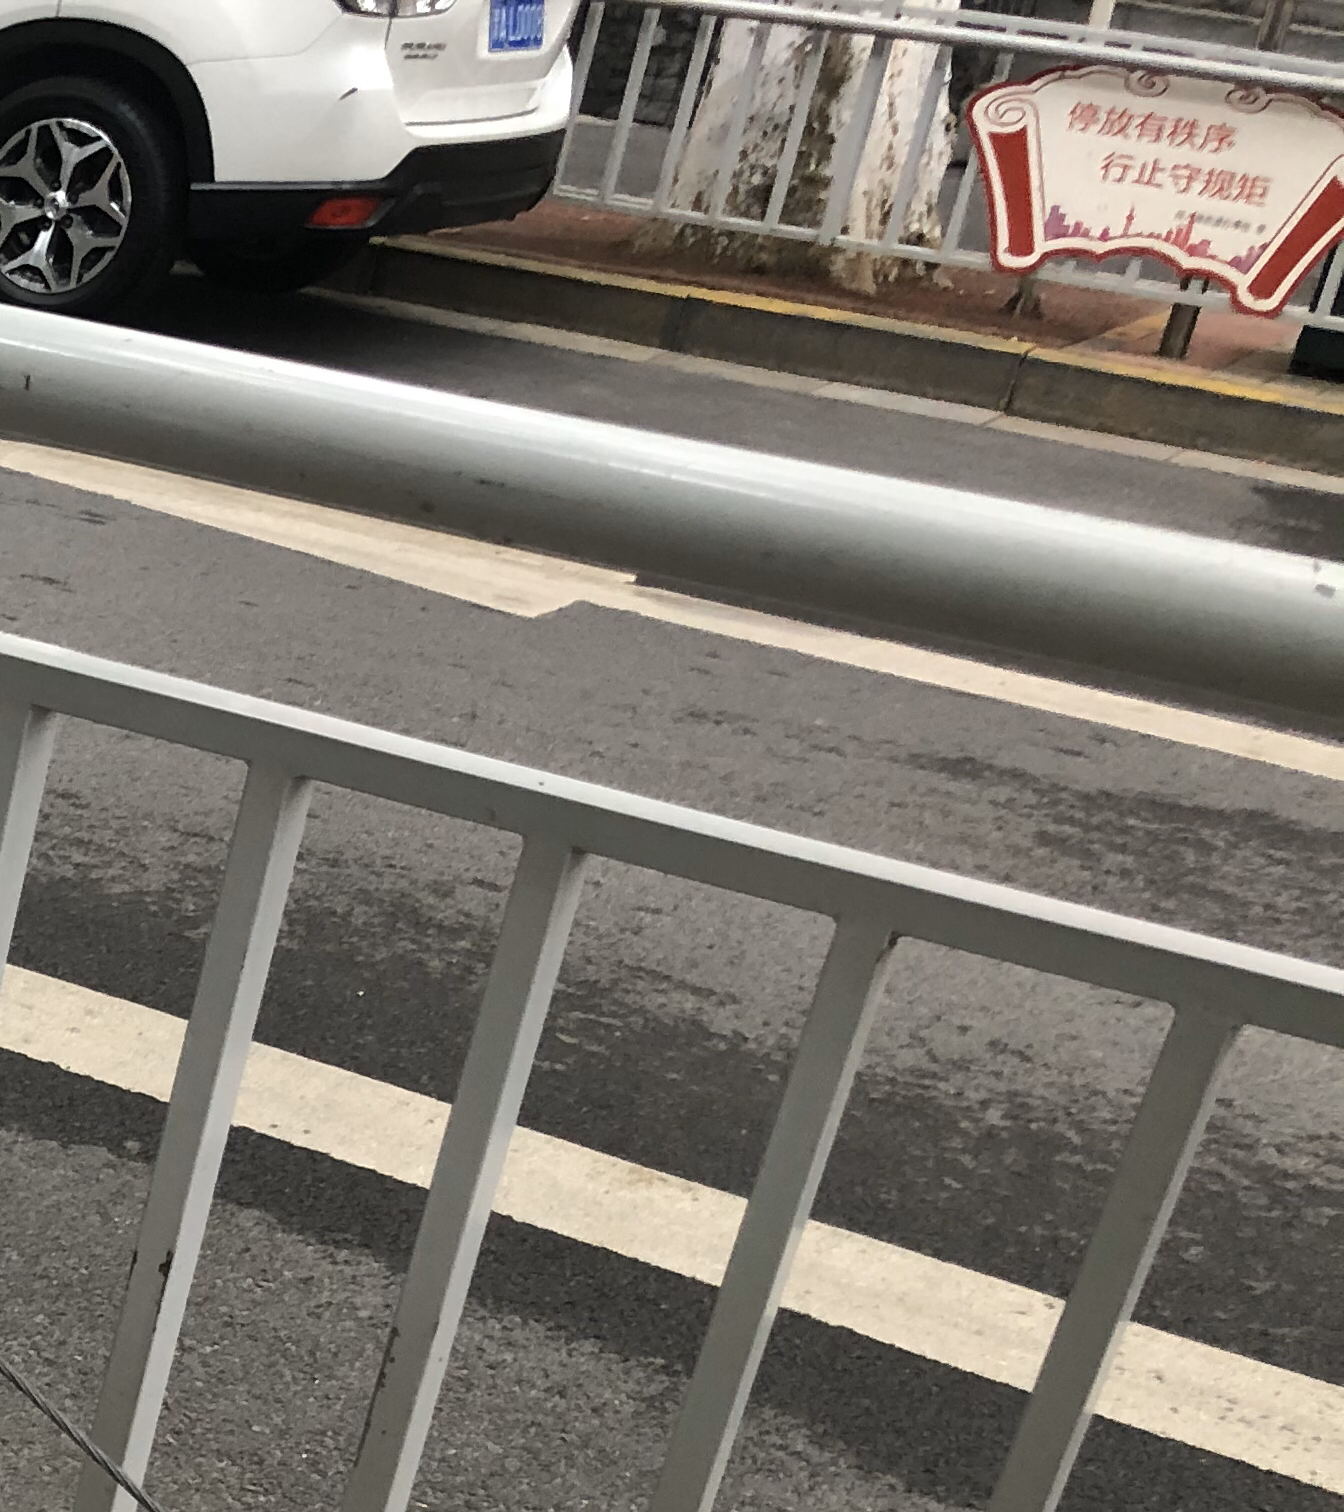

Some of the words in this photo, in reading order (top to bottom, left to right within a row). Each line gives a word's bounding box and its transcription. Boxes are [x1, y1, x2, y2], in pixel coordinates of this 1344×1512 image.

[1068, 101, 1237, 152] 停放有秩序
[1100, 152, 1271, 206] 行止守规矩
